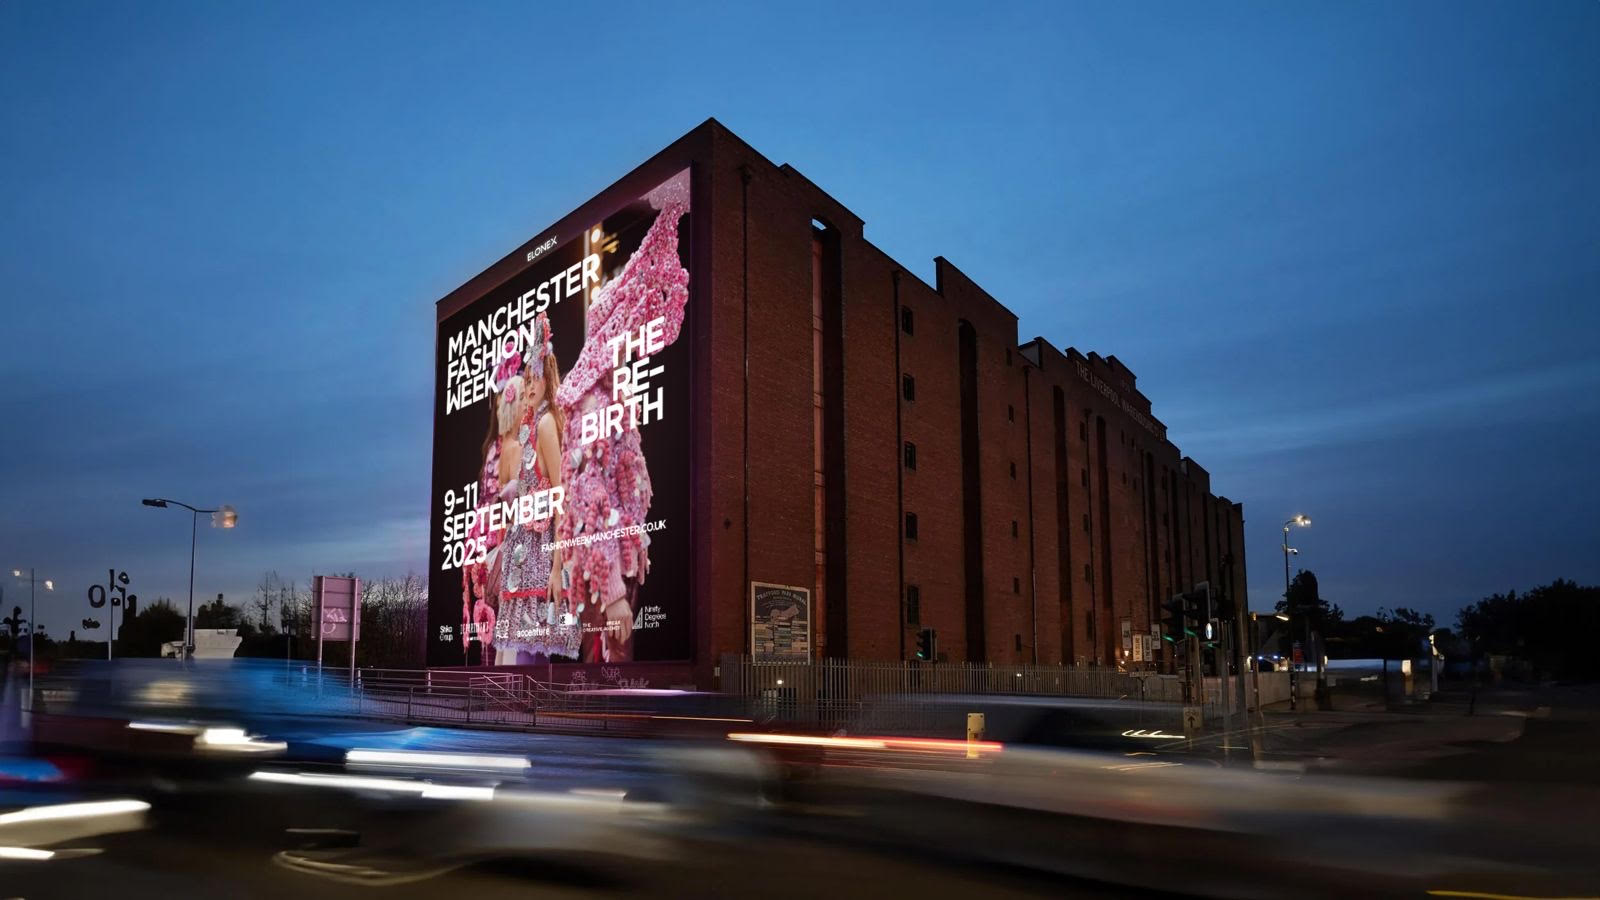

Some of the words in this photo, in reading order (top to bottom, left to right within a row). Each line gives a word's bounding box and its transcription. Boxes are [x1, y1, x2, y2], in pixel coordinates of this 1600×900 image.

[527, 235, 558, 262] ELONEX
[448, 254, 601, 361] MANCHESTER
[447, 318, 536, 389] FASHION
[607, 316, 665, 367] THE
[446, 366, 499, 415] WEEK
[612, 357, 665, 402] RE-
[581, 387, 664, 446] BIRTH
[443, 486, 565, 543] SEPTEMBER
[444, 481, 478, 516] 9-11
[441, 536, 487, 571] 2025
[541, 519, 667, 553] FASHIONWEEKMANCHESTER.CO.UK
